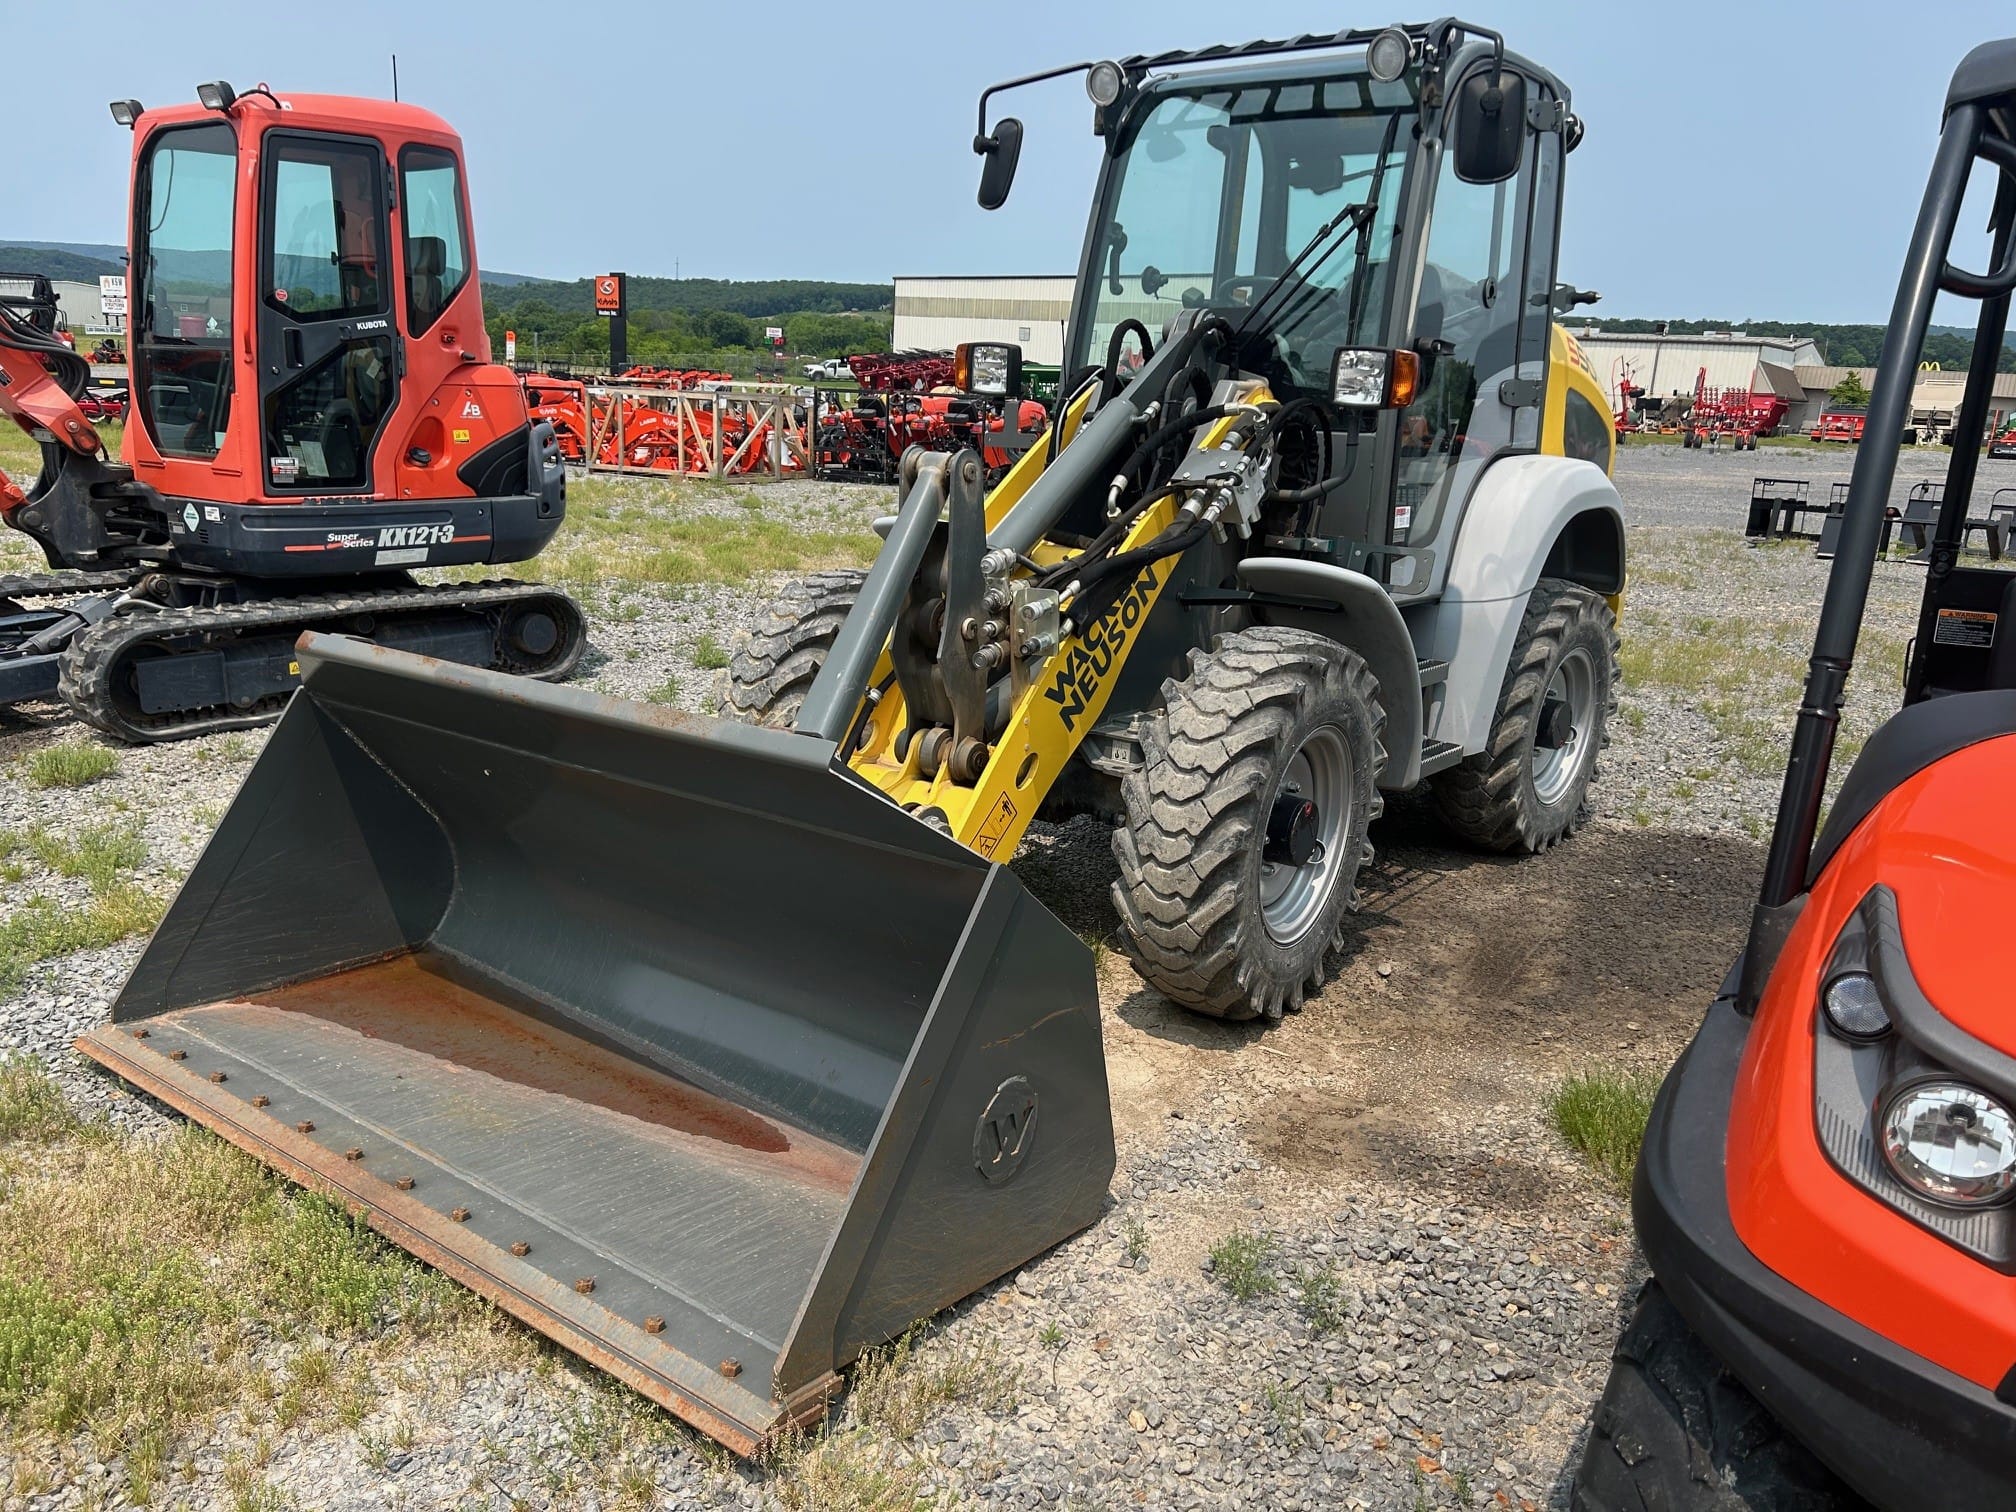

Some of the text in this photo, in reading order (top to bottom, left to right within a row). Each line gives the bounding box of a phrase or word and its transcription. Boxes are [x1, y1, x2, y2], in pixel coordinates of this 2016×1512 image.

[597, 297, 618, 306] Kubota
[356, 319, 388, 331] KUBOTA
[327, 533, 359, 544] Super
[378, 524, 455, 548] KX121-3
[342, 538, 375, 548] Series
[1044, 574, 1140, 705] WACK
[1059, 565, 1159, 733] NEUSON
